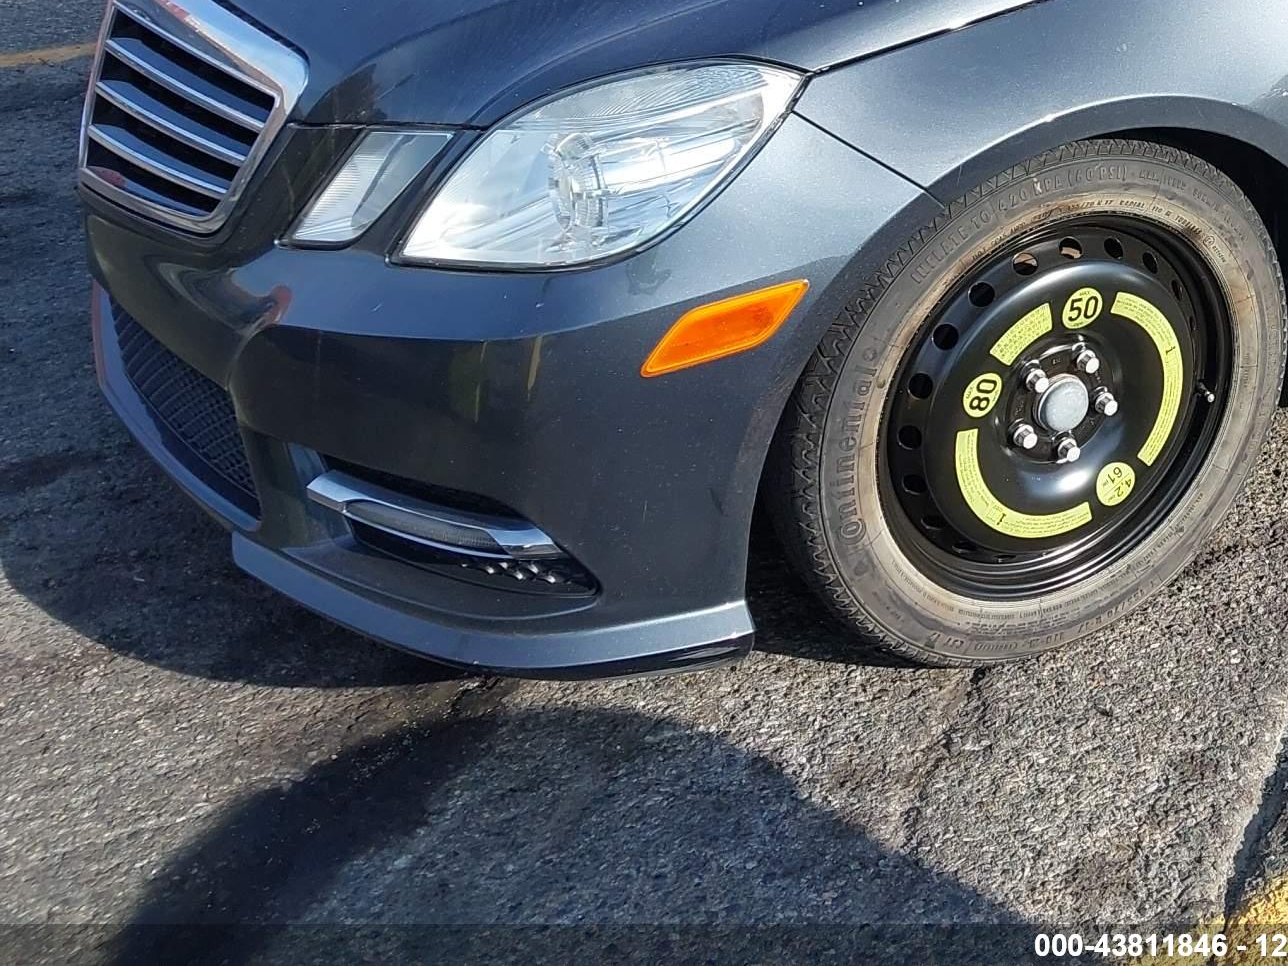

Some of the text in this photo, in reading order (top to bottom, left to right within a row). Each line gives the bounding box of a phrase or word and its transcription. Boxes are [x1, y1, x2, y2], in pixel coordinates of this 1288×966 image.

[1068, 295, 1098, 322] 50
[969, 378, 997, 411] 80
[829, 365, 878, 546] Continental
[1107, 466, 1123, 485] 61
